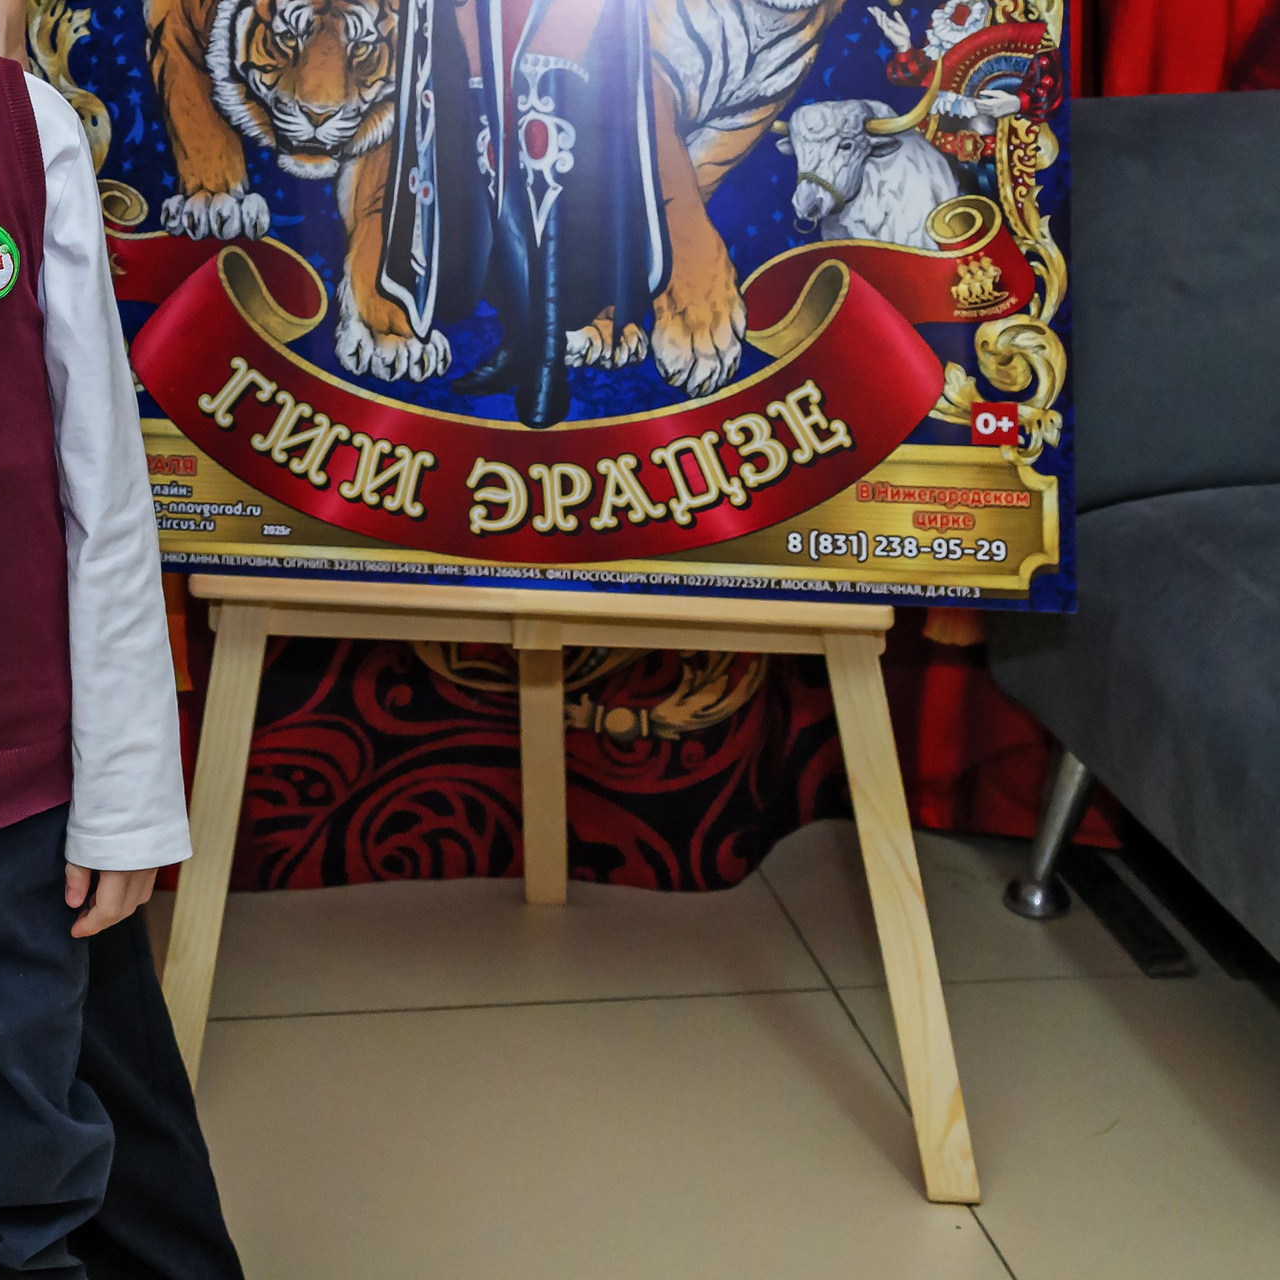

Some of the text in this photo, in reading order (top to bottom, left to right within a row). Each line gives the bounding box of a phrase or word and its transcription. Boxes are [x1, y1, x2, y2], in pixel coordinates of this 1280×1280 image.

[974, 412, 1015, 436] 0+
[196, 356, 853, 535] ГИИ ЭРАДЗЕ
[152, 482, 192, 497] лайн:
[858, 483, 1031, 509] В Нижегородском
[153, 500, 262, 518] s-nnovgorod.ru
[157, 516, 215, 532] circus.ru
[914, 512, 975, 532] цирке
[786, 529, 1008, 562] 8 (831) 238-95-29
